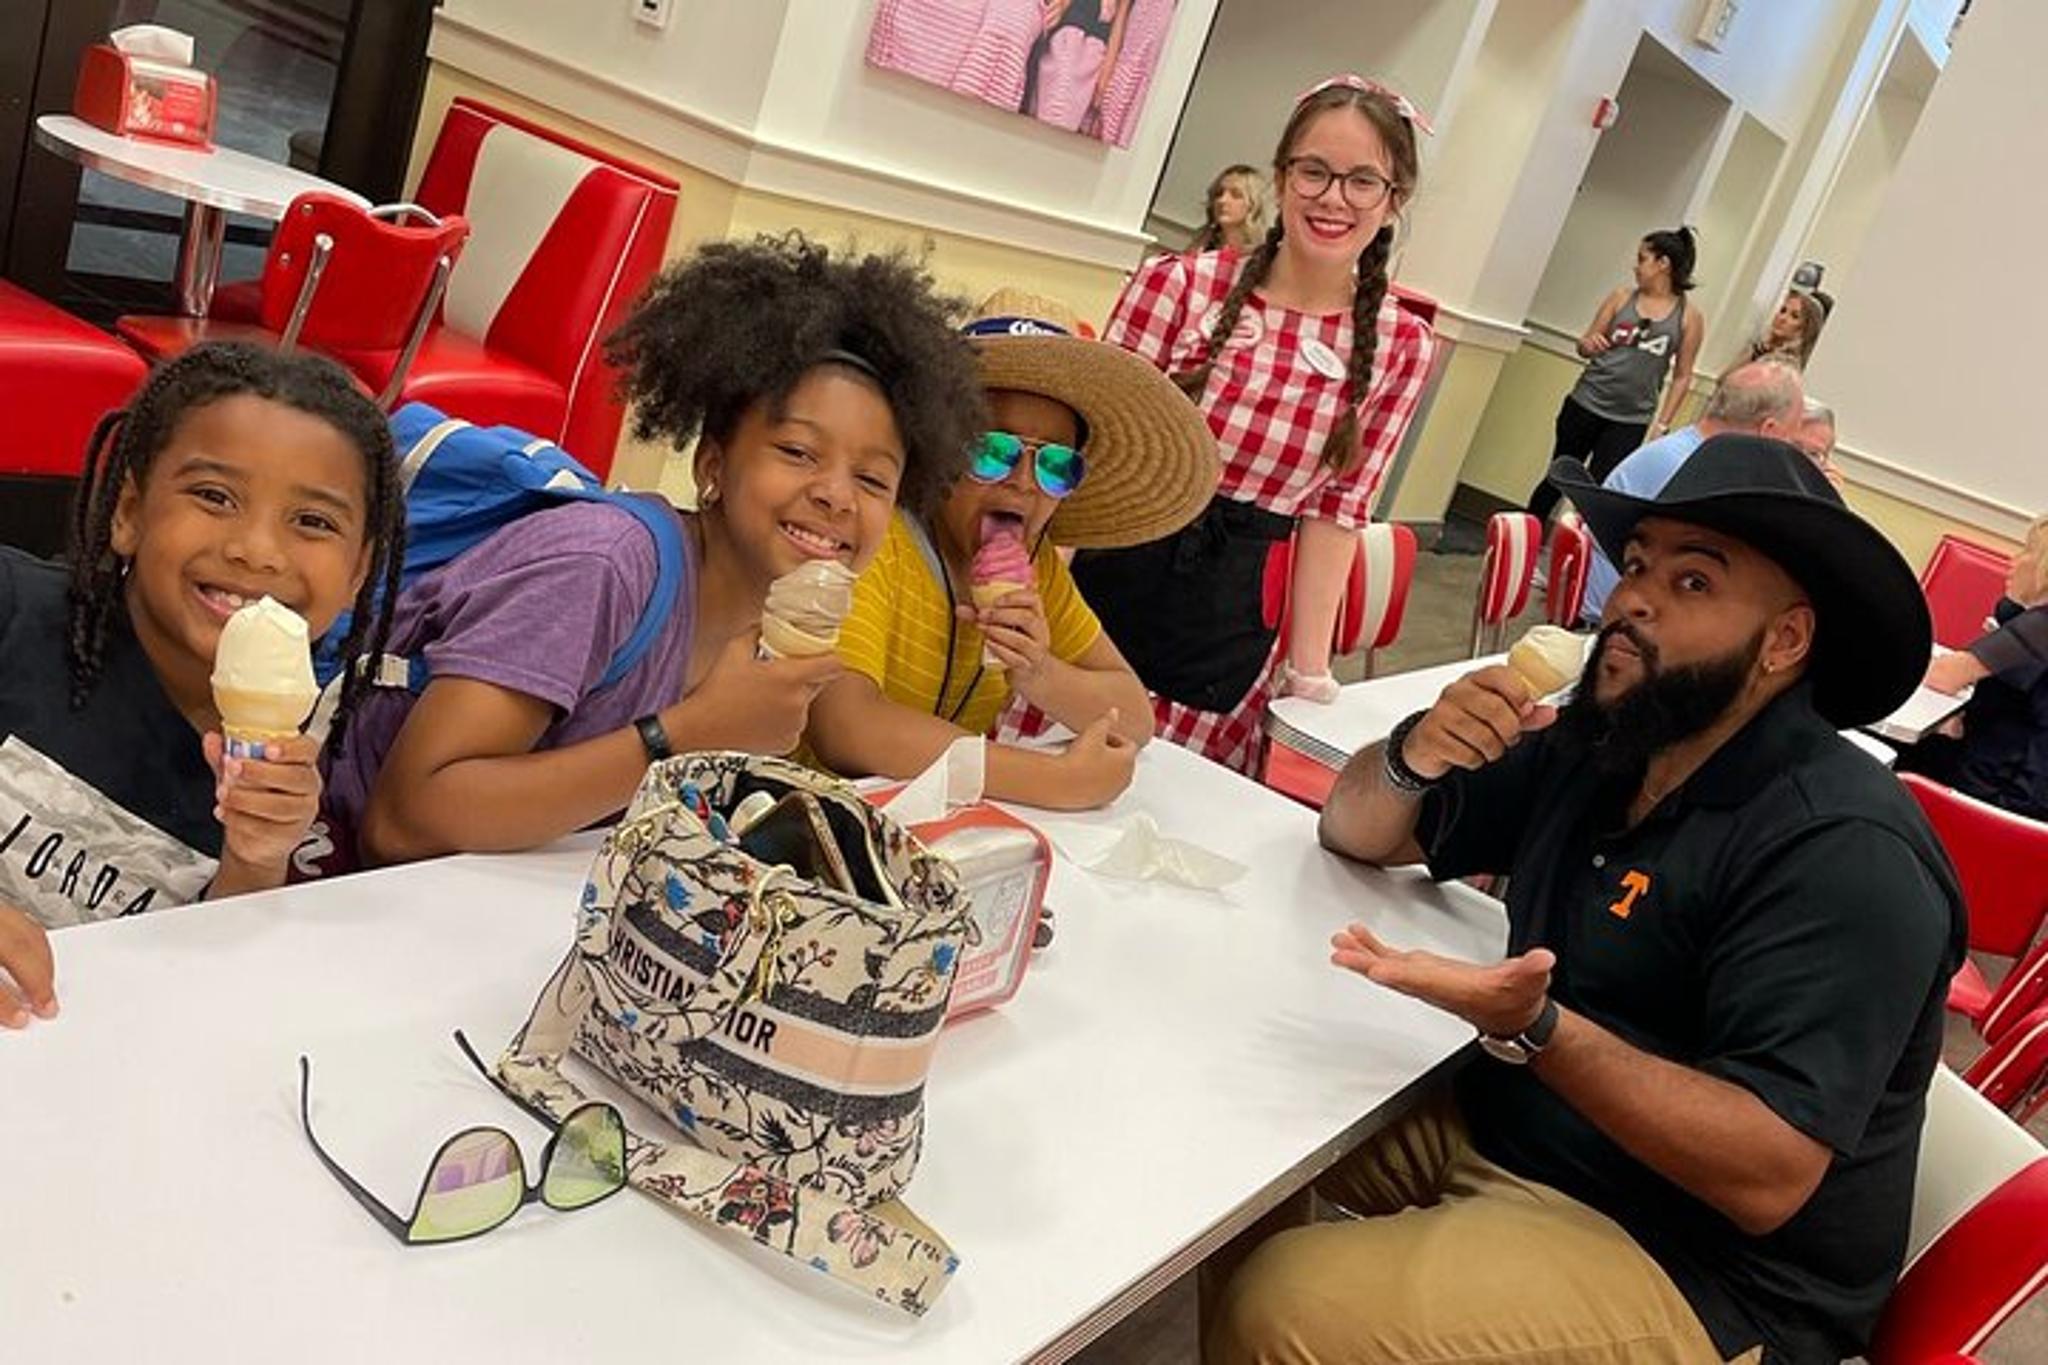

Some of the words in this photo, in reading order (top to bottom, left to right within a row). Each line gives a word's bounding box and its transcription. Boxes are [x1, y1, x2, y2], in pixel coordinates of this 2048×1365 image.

[1609, 869, 1650, 919] T
[611, 926, 696, 1003] HRISTIA
[723, 1006, 777, 1053] IOR
